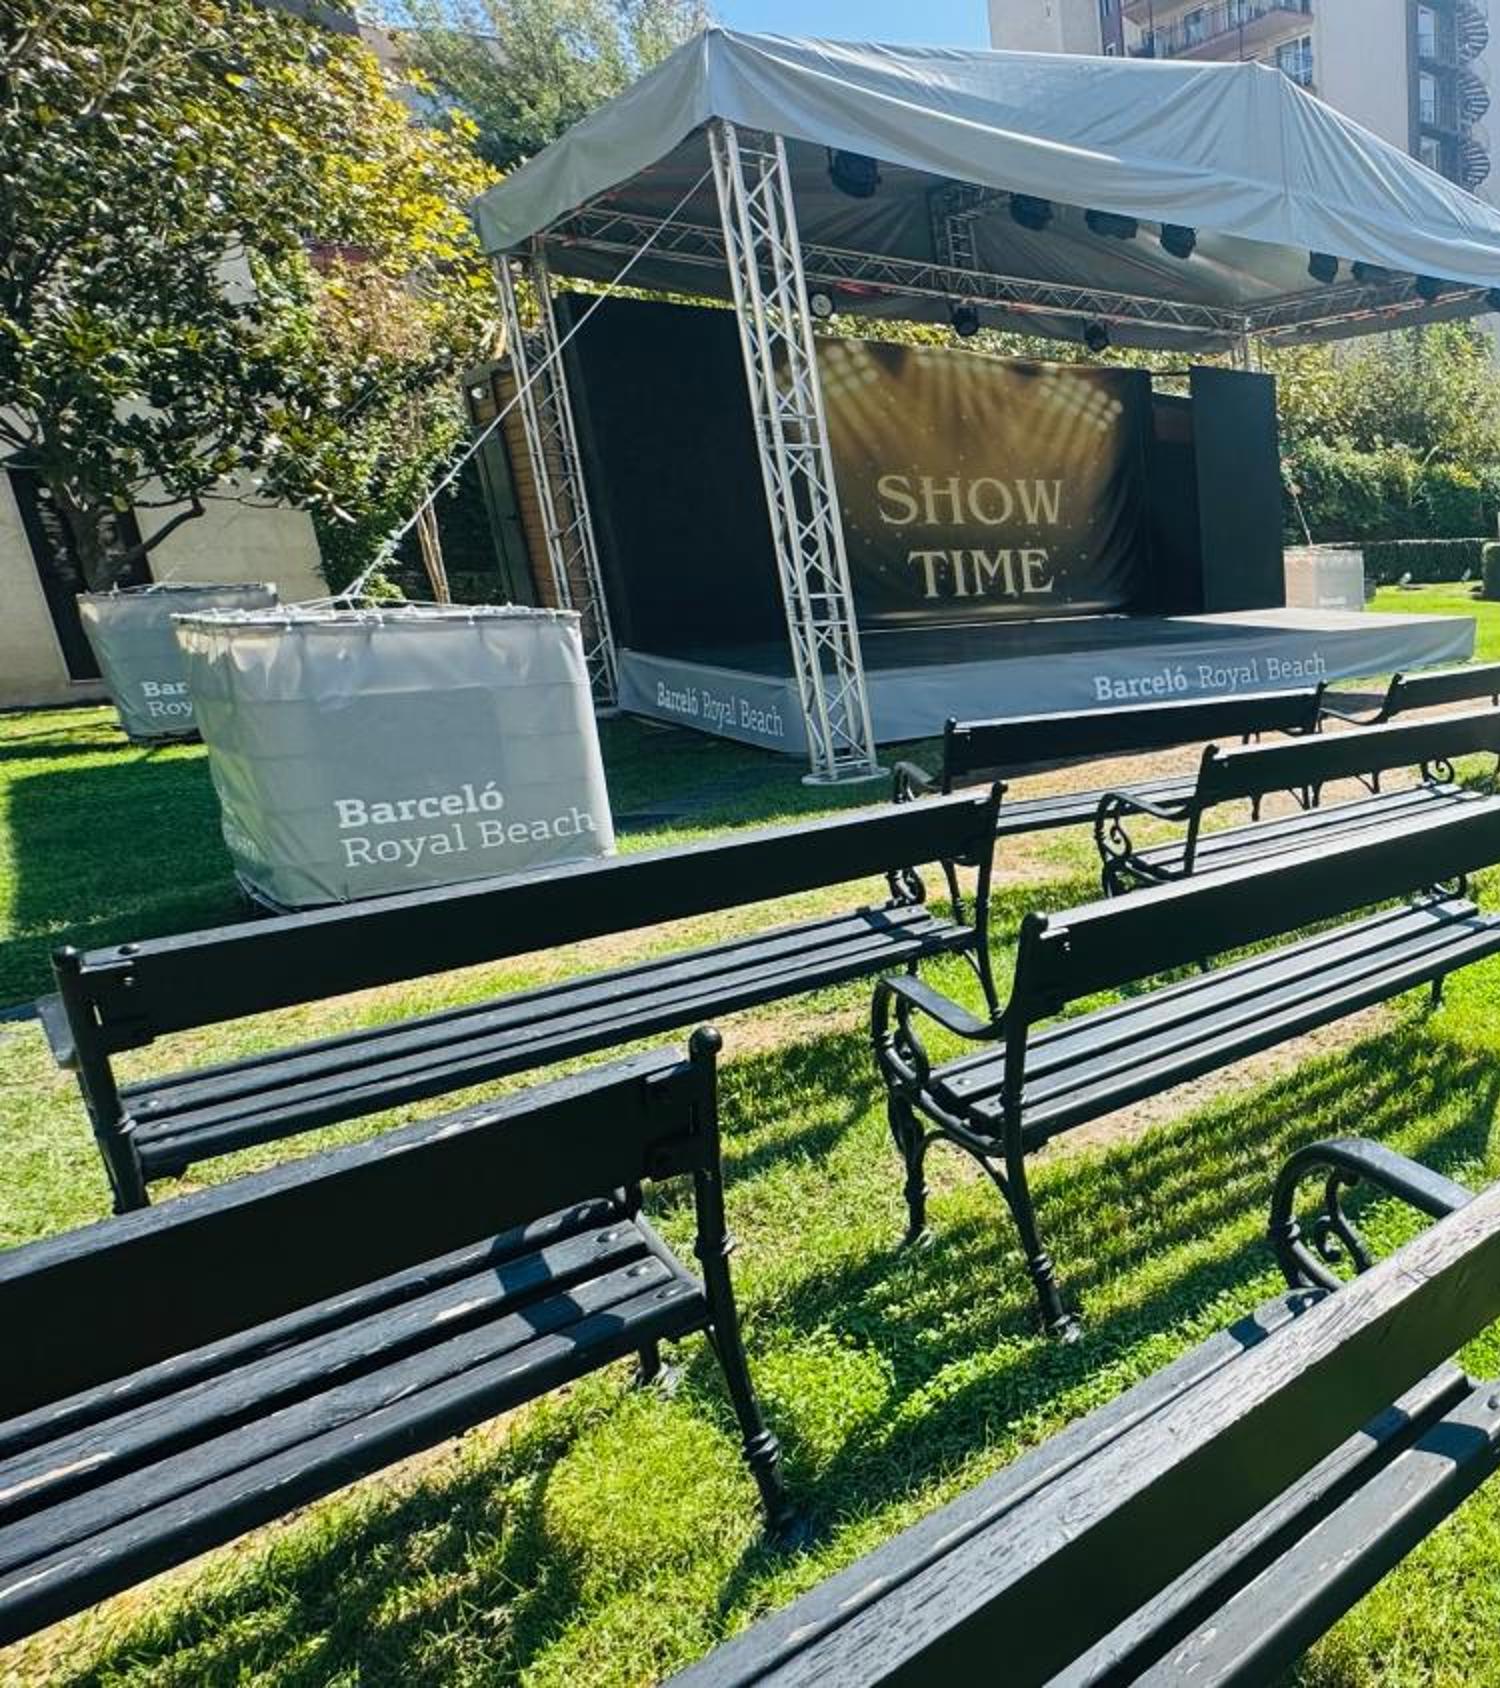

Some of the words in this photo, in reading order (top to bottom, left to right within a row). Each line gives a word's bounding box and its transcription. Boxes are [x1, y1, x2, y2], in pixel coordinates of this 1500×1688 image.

[877, 475, 1064, 526] SHOW
[907, 549, 1055, 599] TIME
[1093, 662, 1189, 701] Barceló
[1198, 658, 1260, 692] Royal
[1266, 651, 1328, 681] Beach
[656, 681, 699, 717] Barceló
[702, 690, 737, 729] Royal
[740, 698, 785, 737] Beach
[334, 780, 504, 829] Barceló
[340, 822, 469, 868] Royal
[476, 806, 600, 849] Beach
